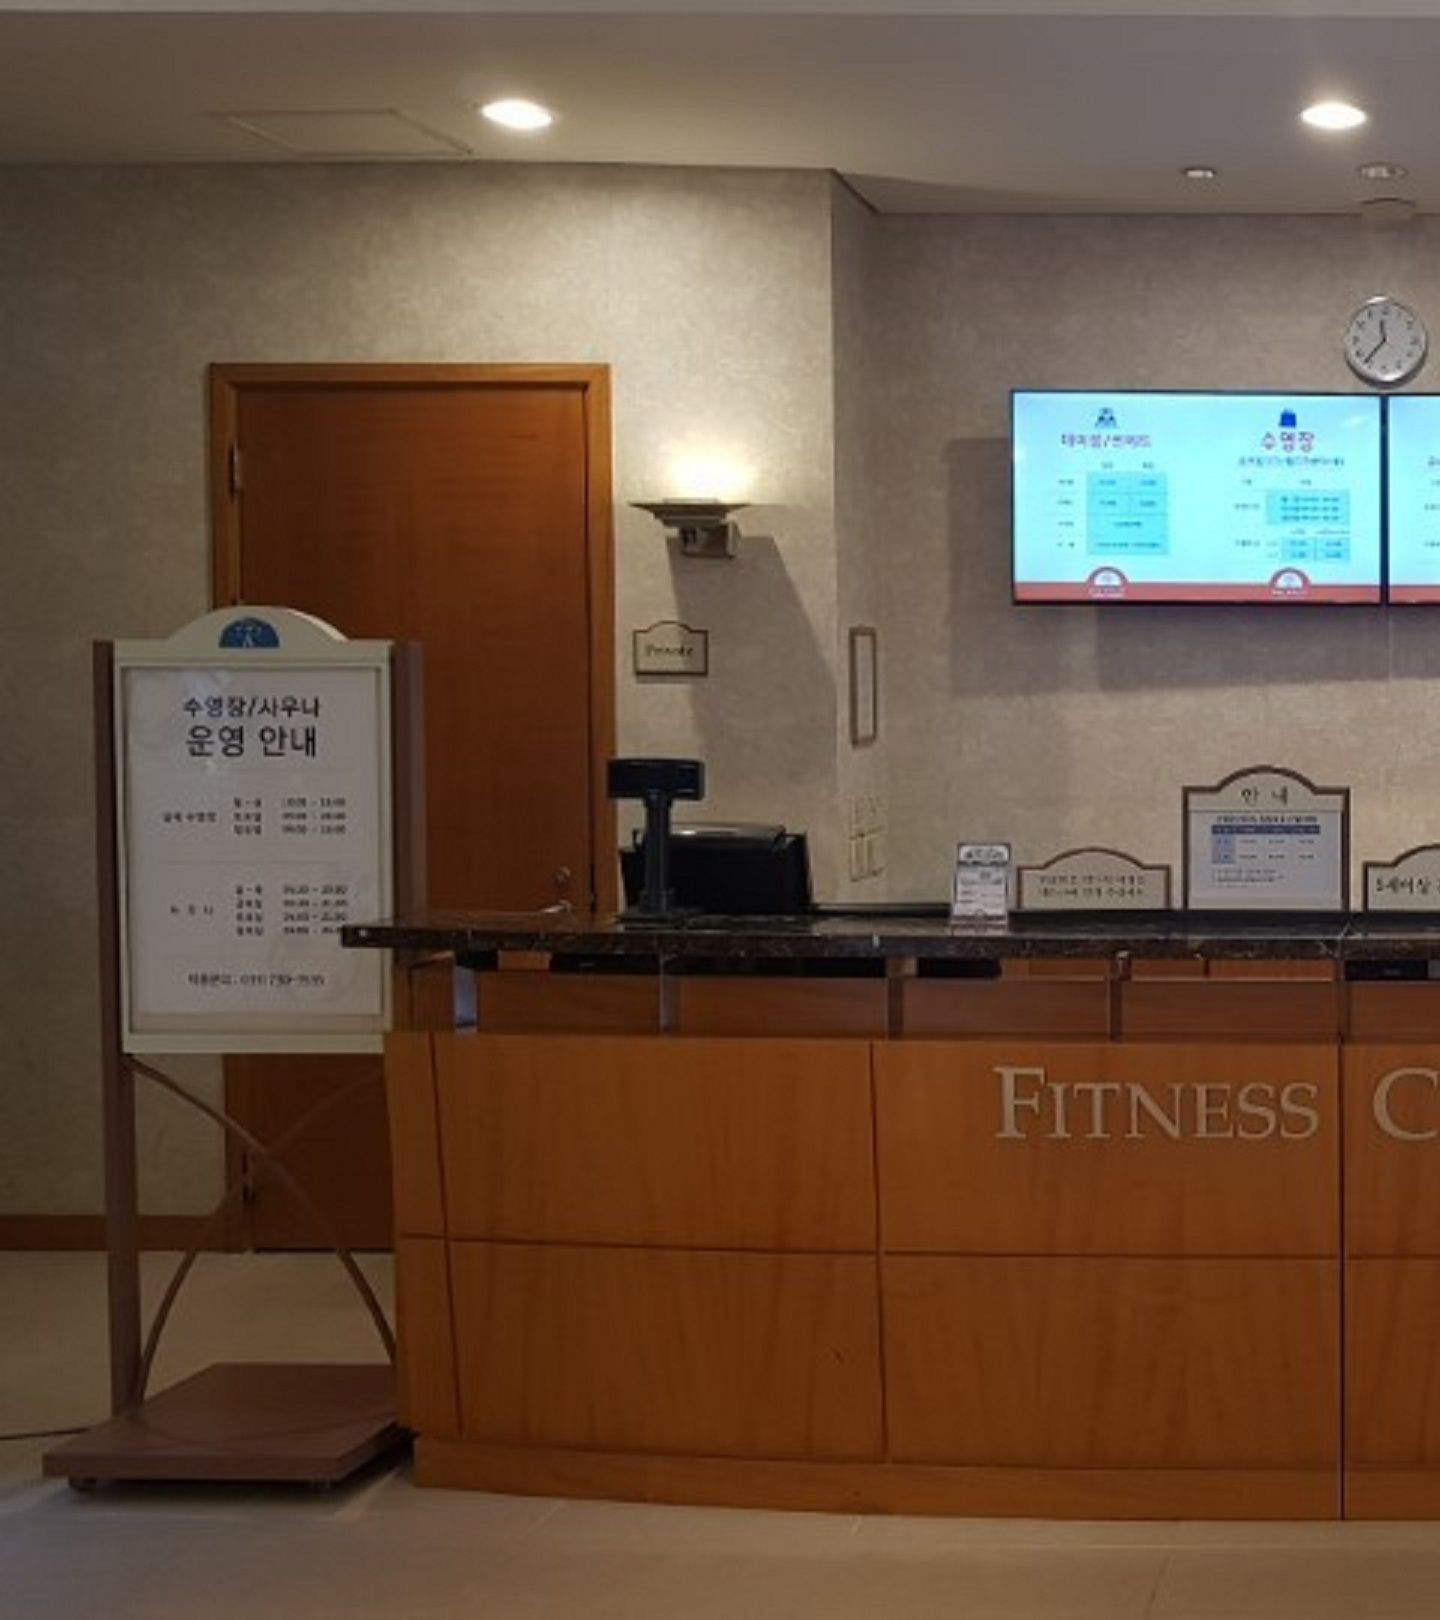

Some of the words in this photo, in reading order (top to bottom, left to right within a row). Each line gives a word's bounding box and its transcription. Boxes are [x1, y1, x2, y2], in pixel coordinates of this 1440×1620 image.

[1262, 431, 1315, 454] 수영장
[183, 696, 320, 719] 수영장/사우나
[187, 725, 245, 758] 운영
[258, 726, 317, 758] 안내
[993, 1066, 1319, 1140] FITNESS
